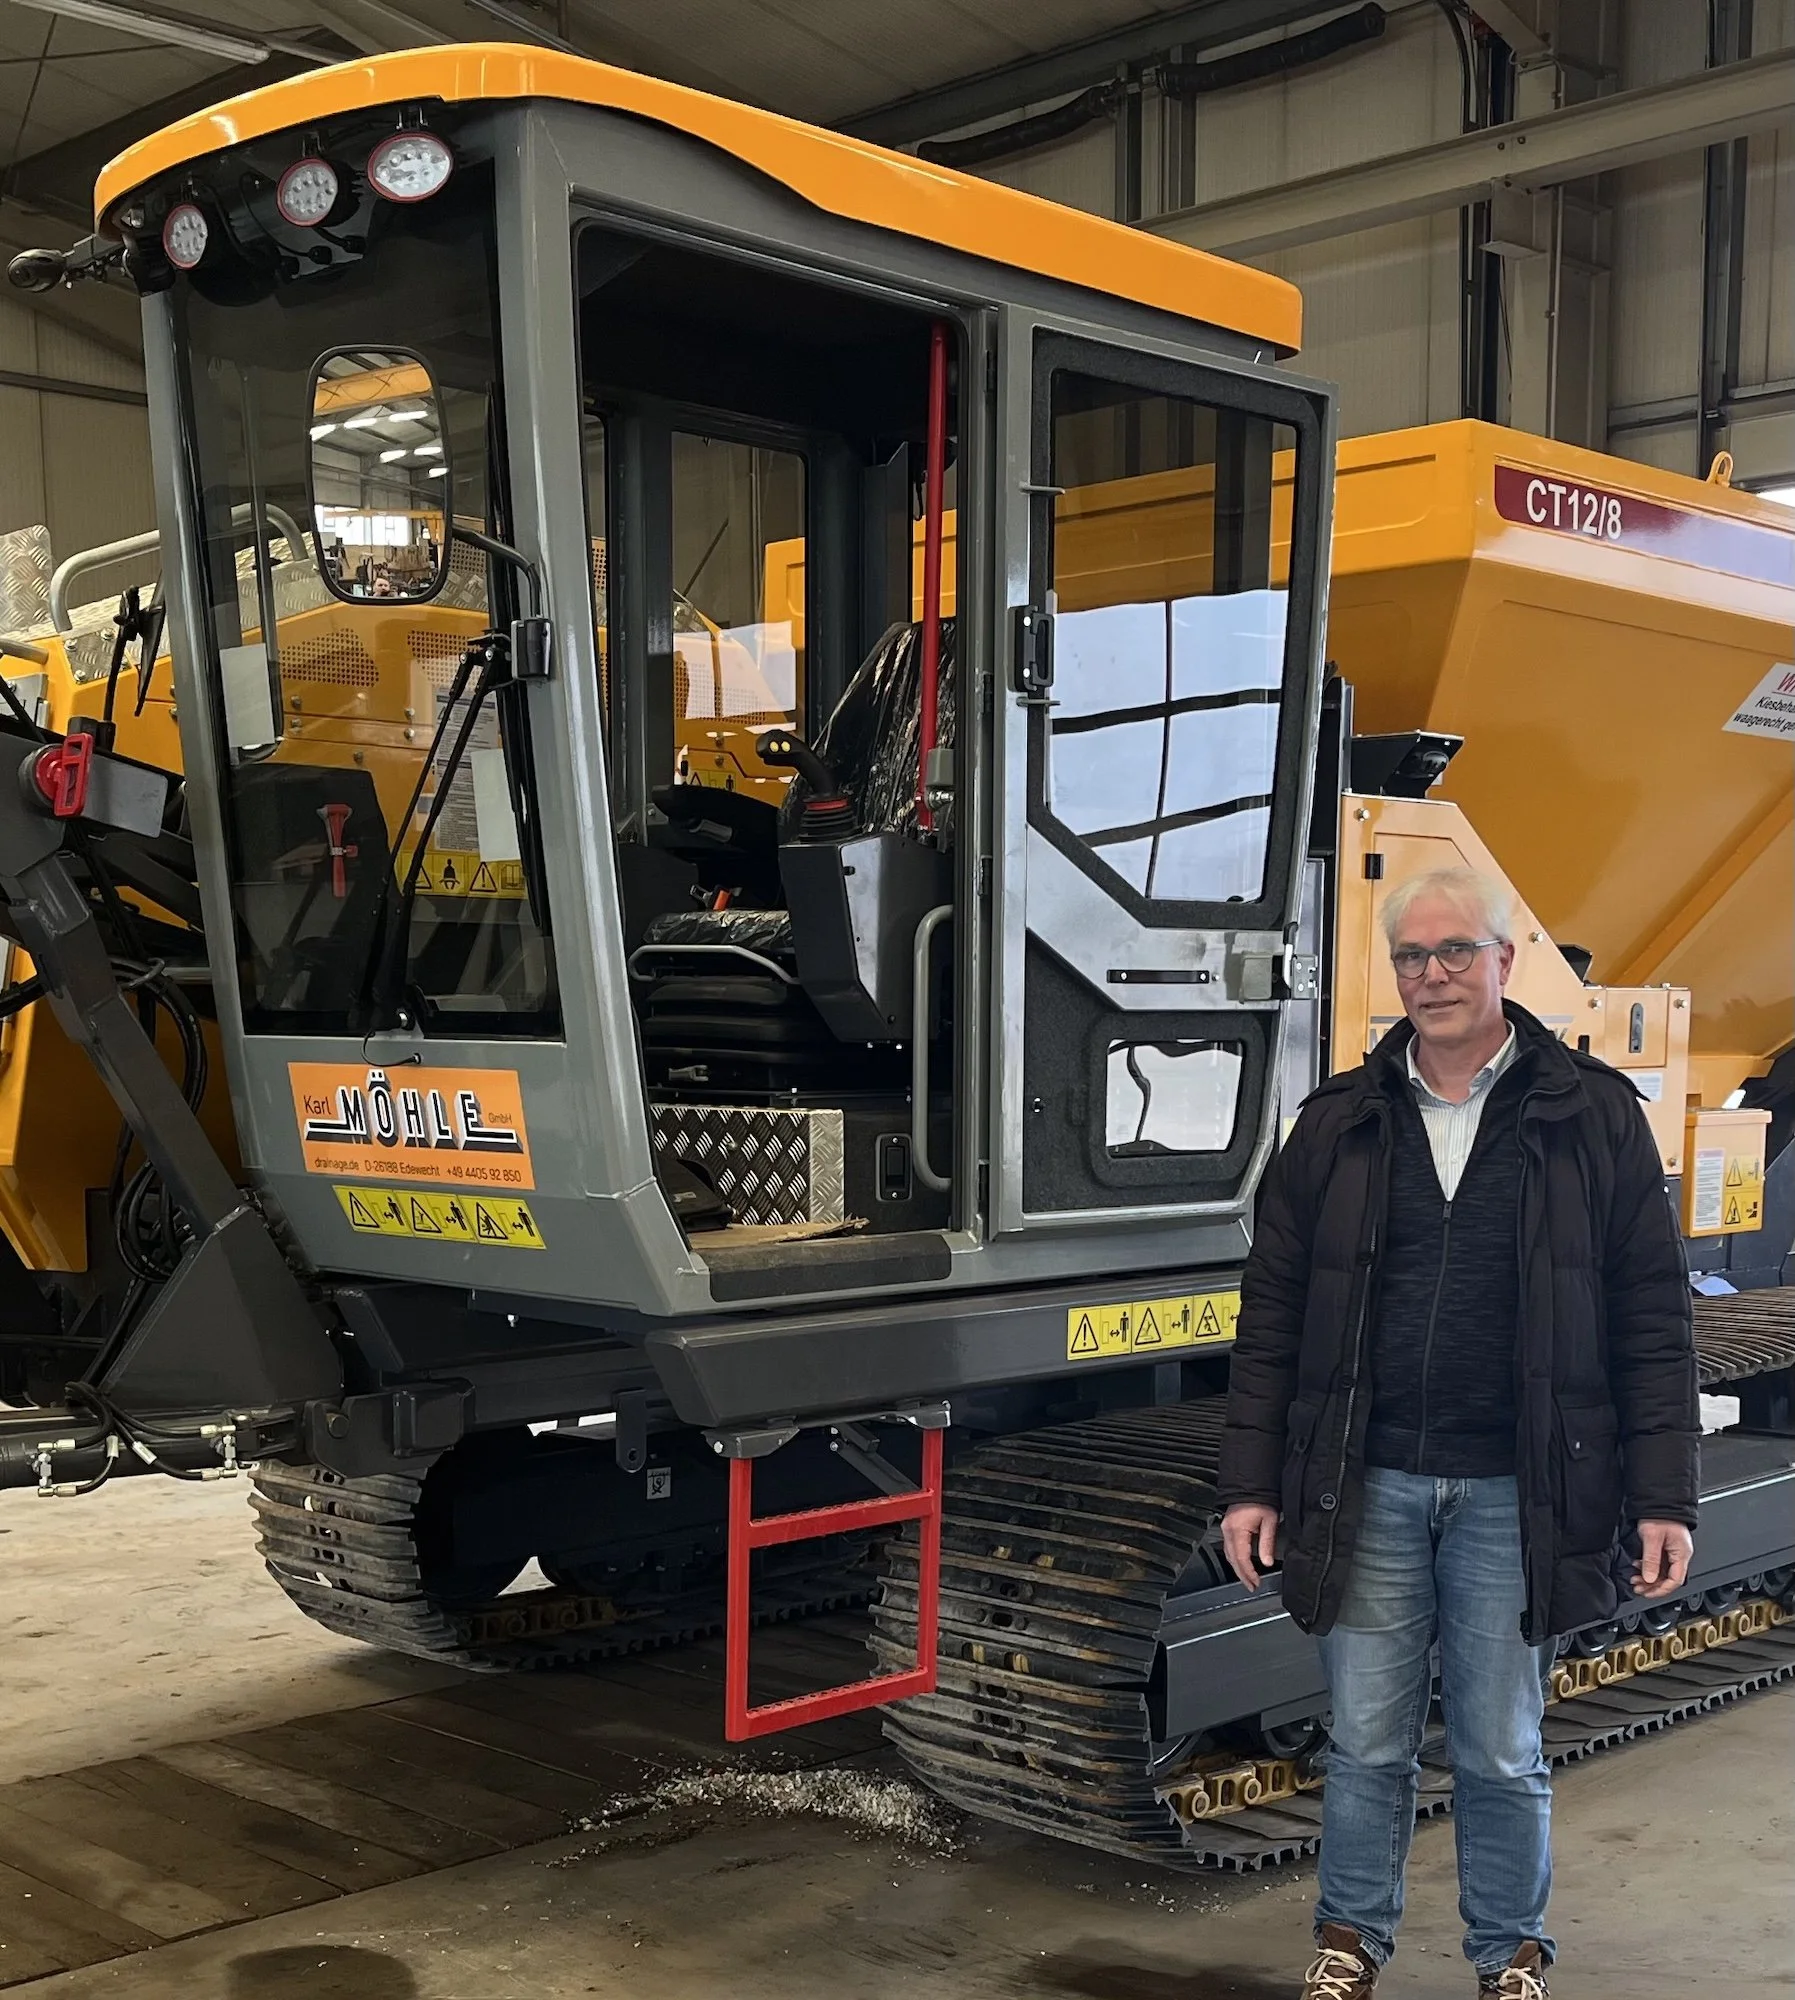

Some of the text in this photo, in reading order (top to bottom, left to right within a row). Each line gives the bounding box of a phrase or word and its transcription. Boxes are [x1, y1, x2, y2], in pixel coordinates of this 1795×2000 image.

[1526, 479, 1622, 540] CT12/8
[1733, 713, 1786, 729] waagerecht
[303, 1068, 524, 1154] Karl MÖHLE GmbH
[314, 1157, 360, 1172] drainage.de
[400, 1161, 440, 1177] Edewecht
[446, 1165, 464, 1178] +49
[465, 1167, 488, 1180] 4405
[489, 1168, 501, 1181] 92
[503, 1169, 522, 1182] 850
